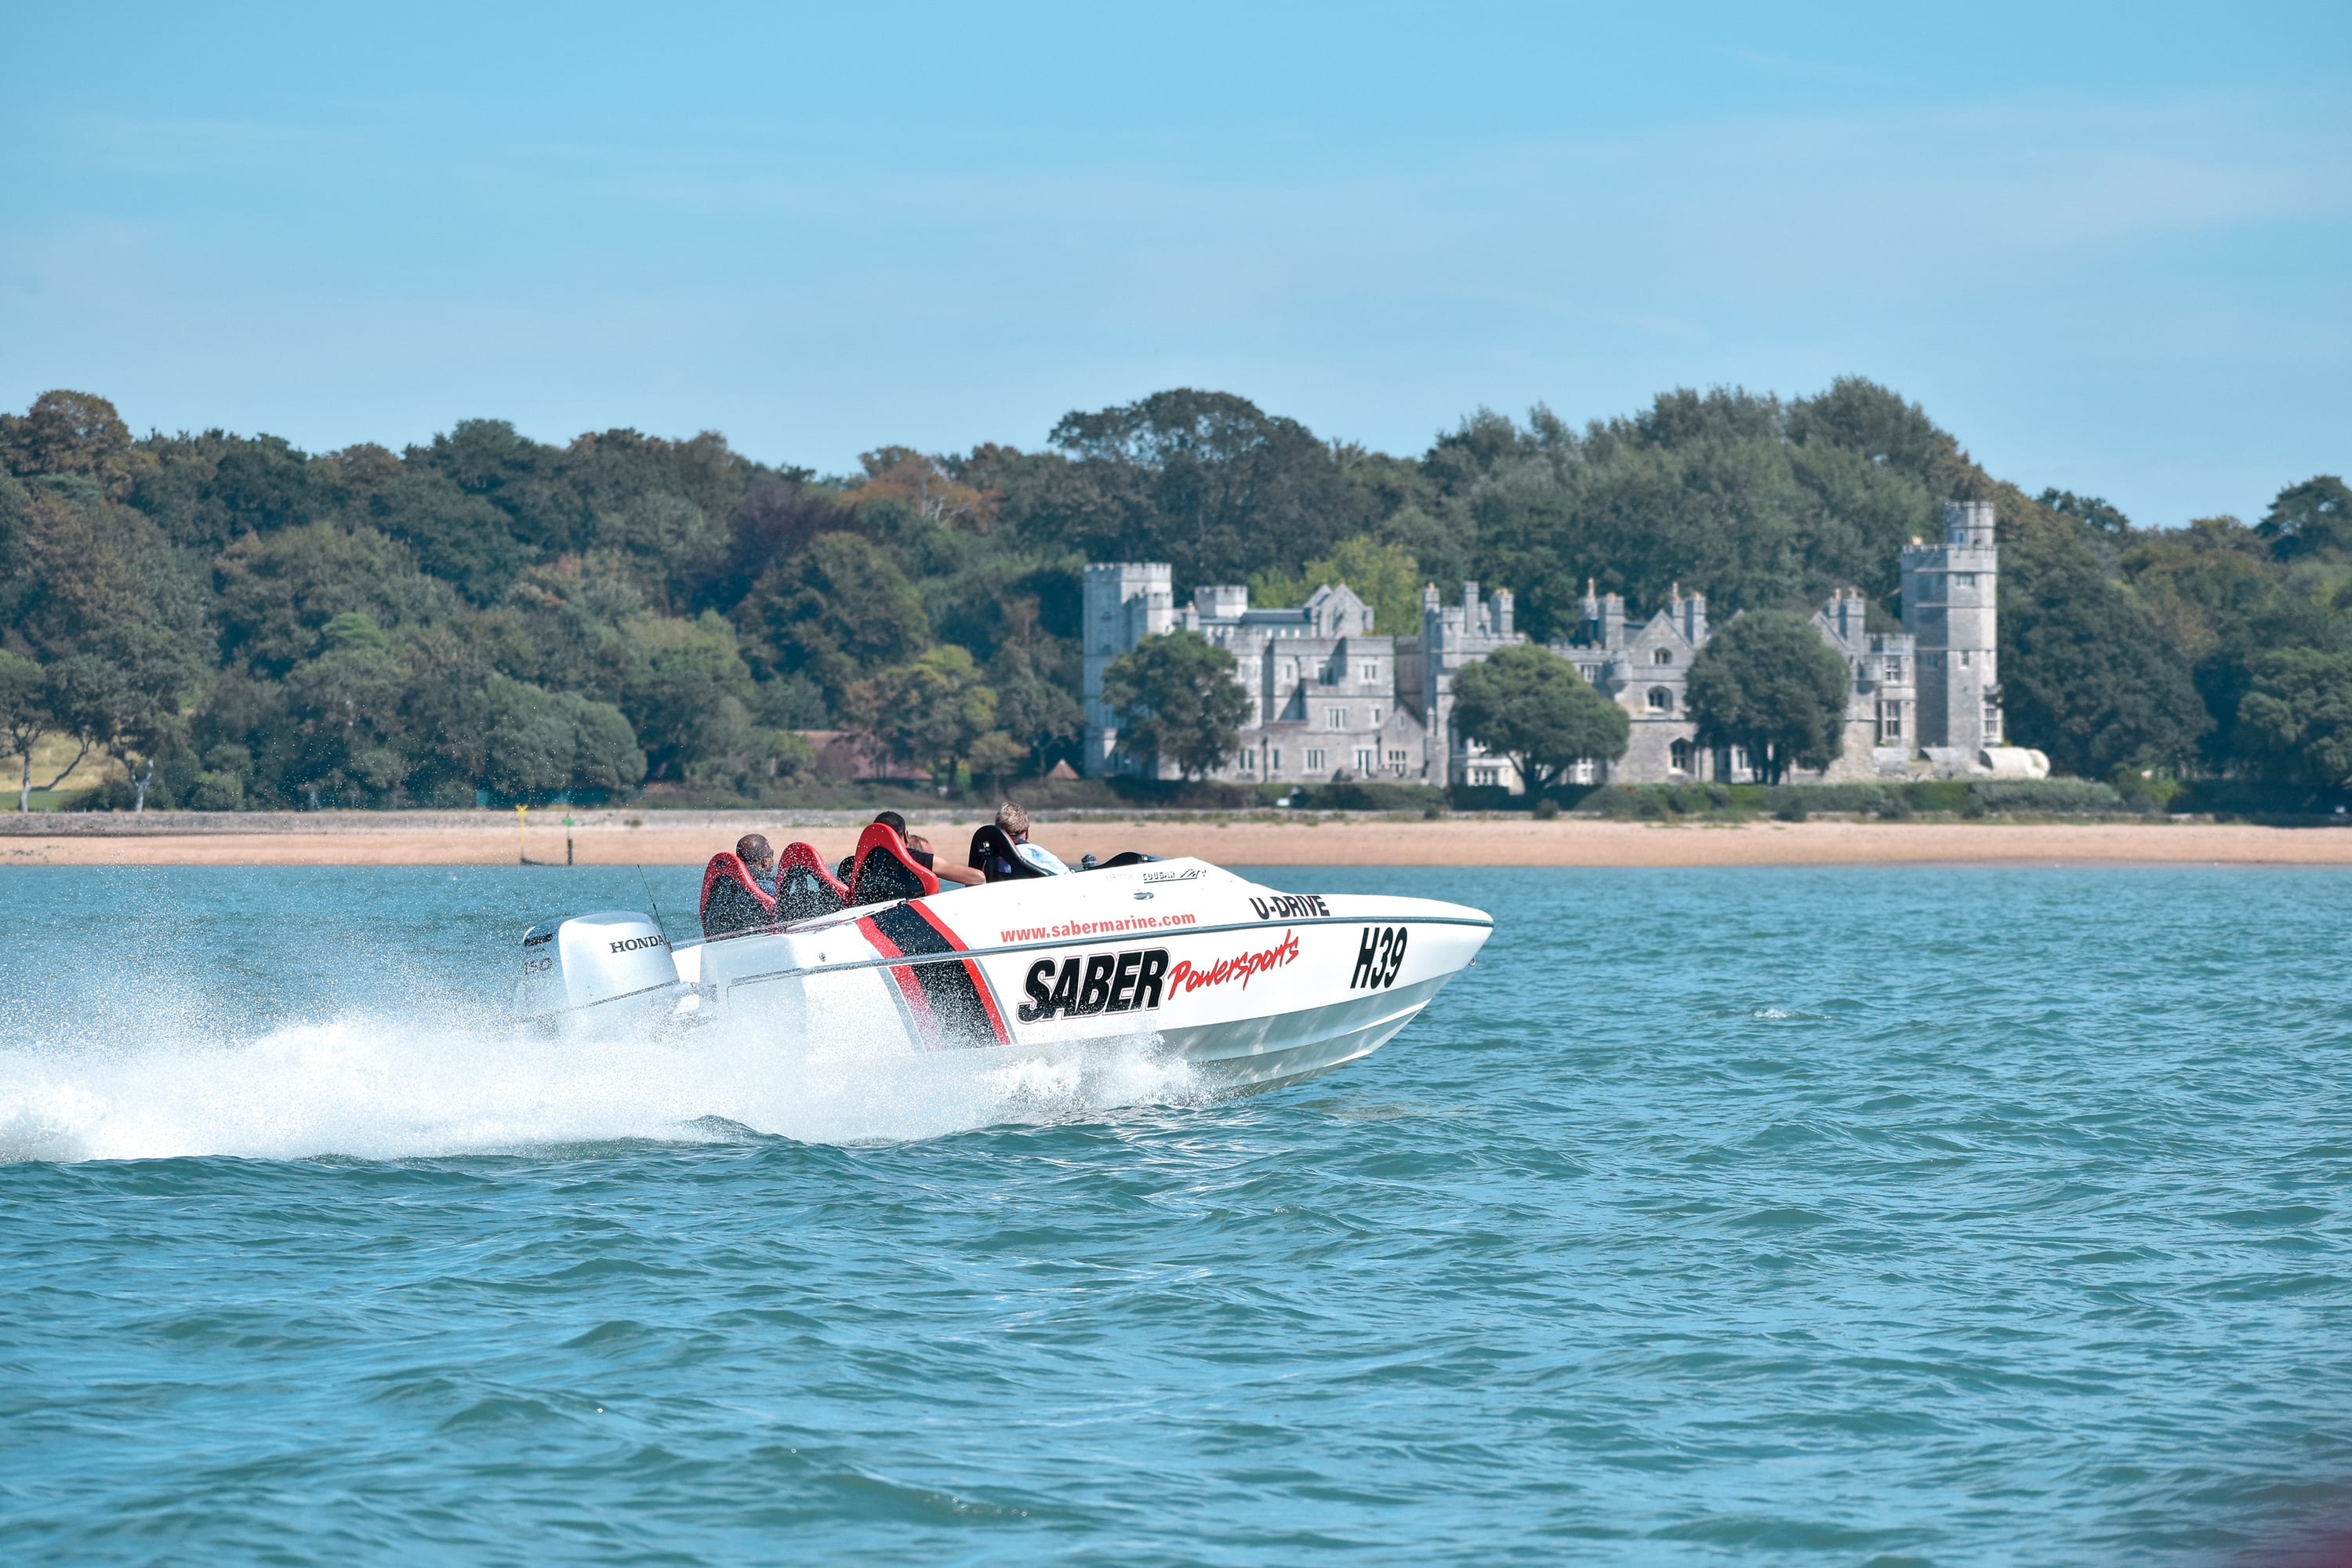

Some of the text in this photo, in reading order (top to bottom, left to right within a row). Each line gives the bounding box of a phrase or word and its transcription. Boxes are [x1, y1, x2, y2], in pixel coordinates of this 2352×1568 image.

[1249, 895, 1330, 920] U-DRIVE
[1000, 913, 1196, 942] www.sabermarine.com
[609, 935, 666, 953] HONDA
[1350, 927, 1407, 989] H39
[1017, 929, 1299, 1024] SABER Powersports
